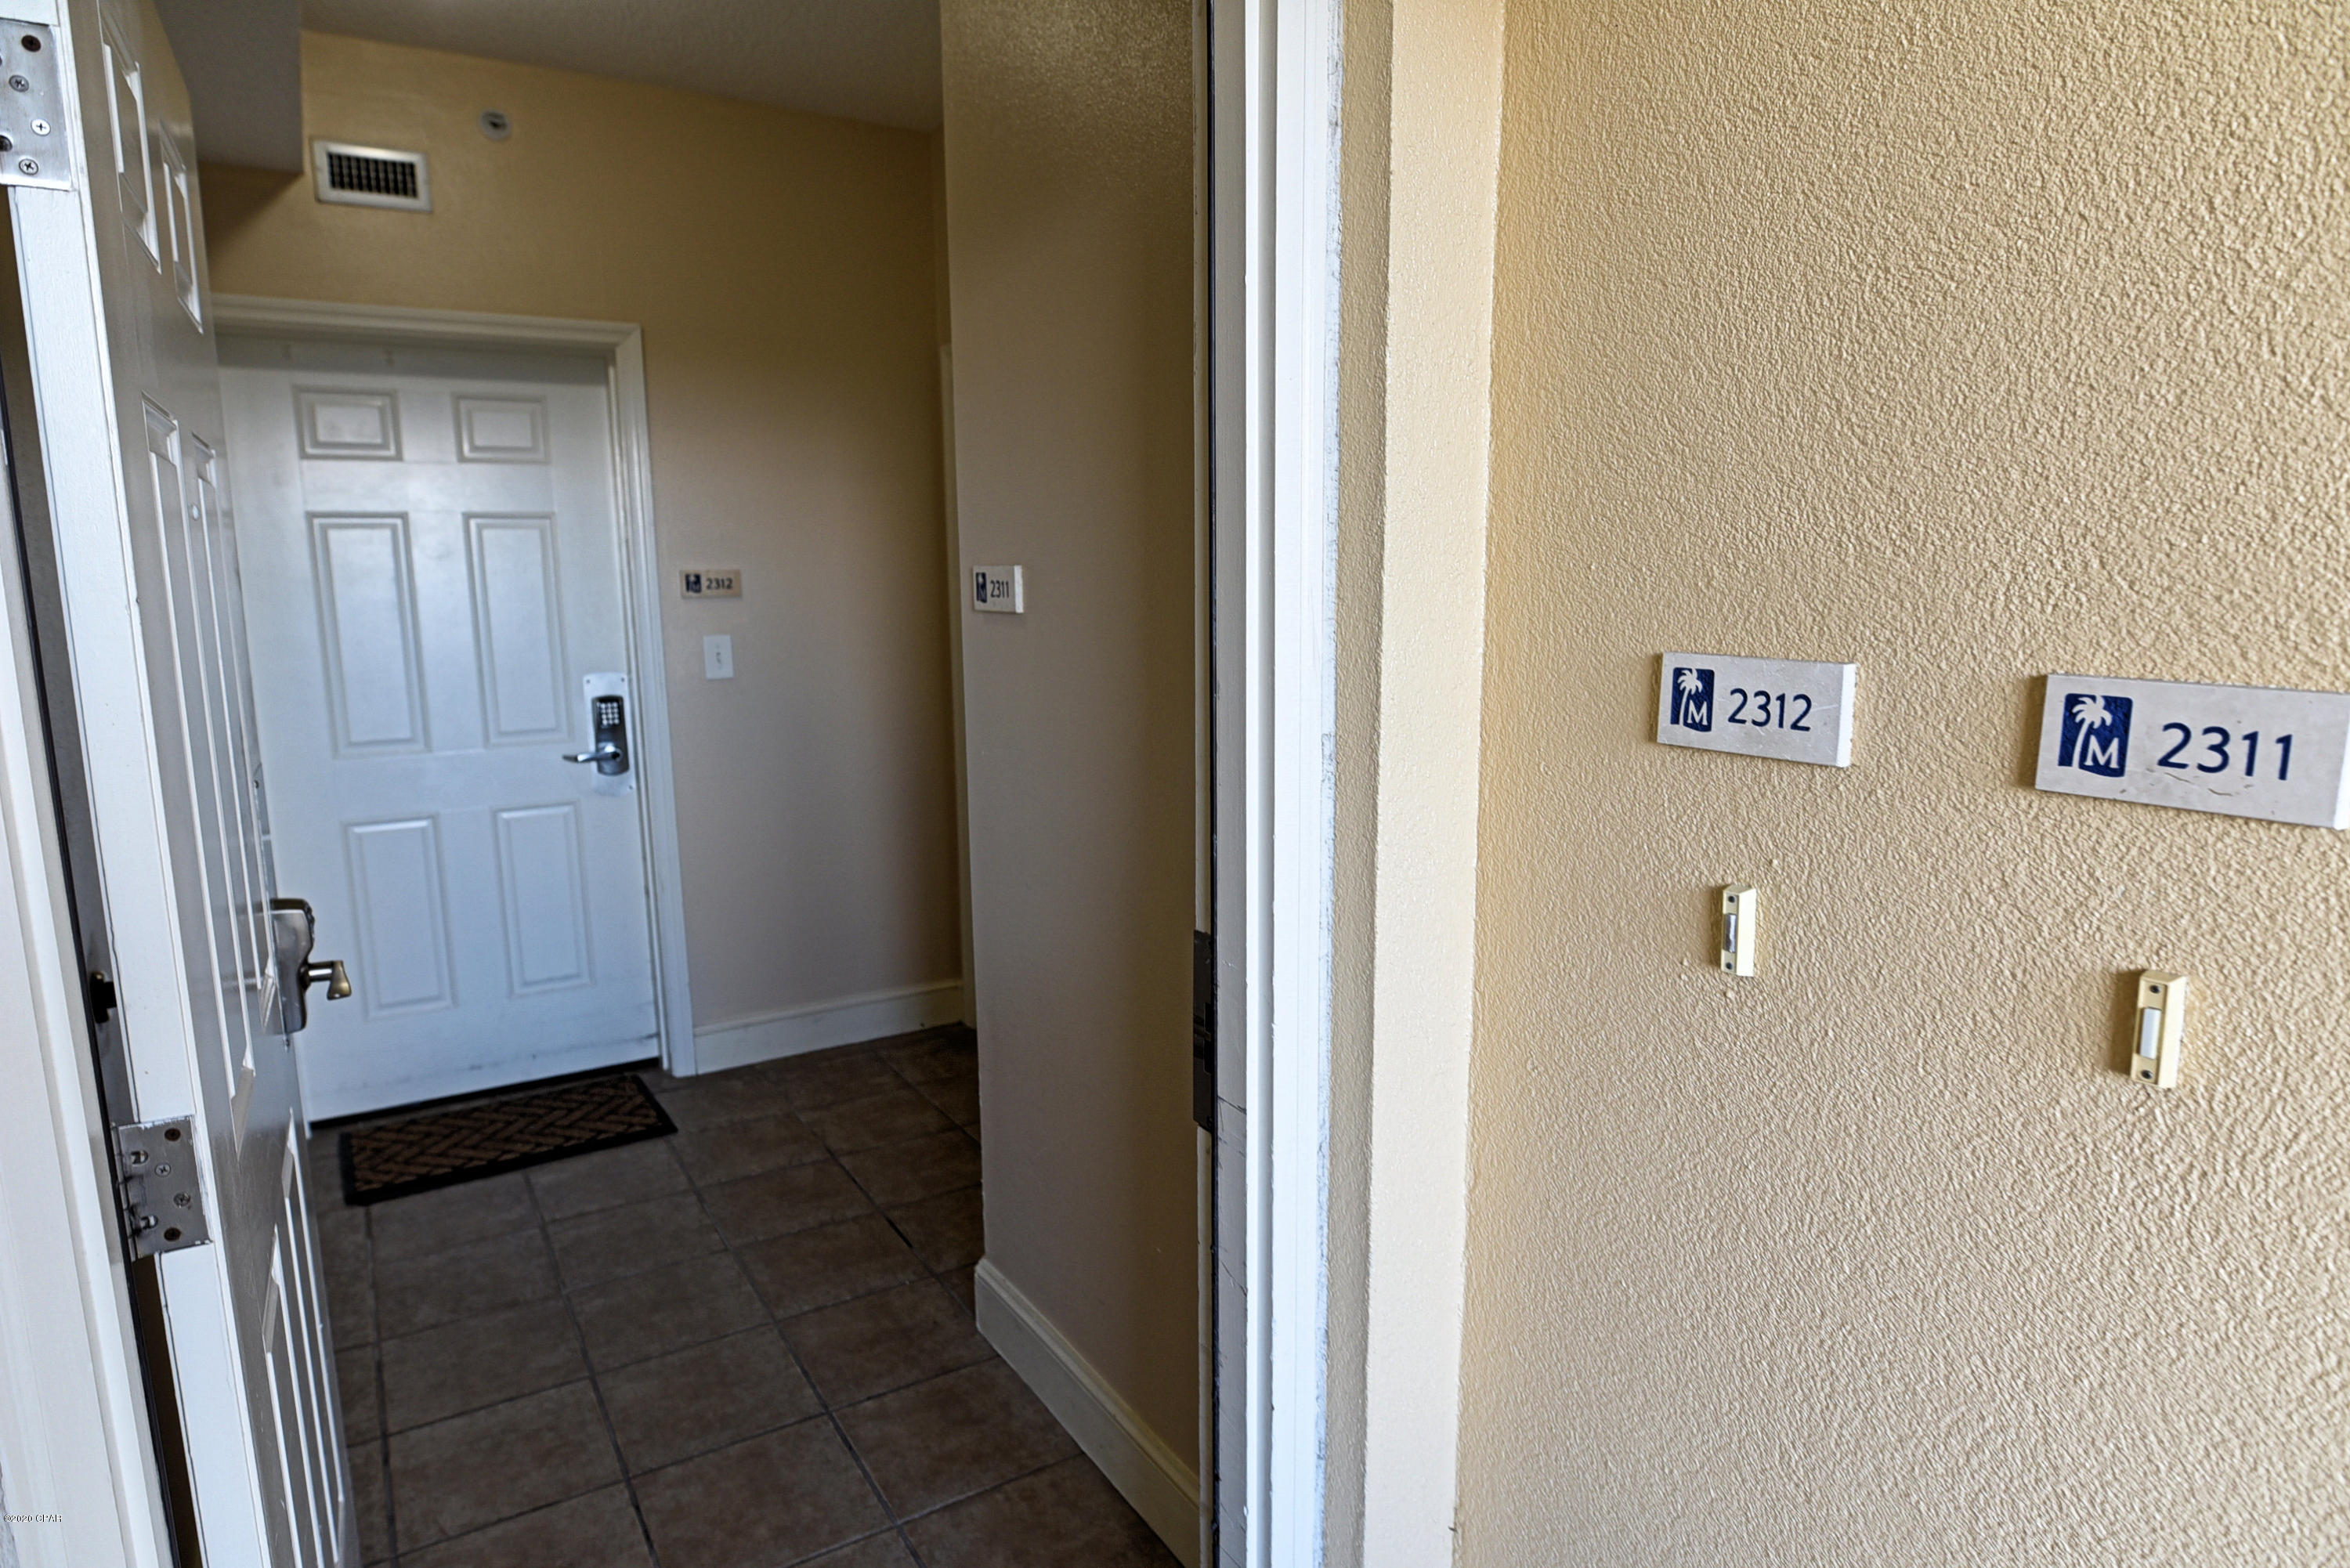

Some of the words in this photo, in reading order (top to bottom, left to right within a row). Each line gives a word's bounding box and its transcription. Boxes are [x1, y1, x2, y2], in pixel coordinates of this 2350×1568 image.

[706, 577, 733, 591] 2312
[990, 580, 1010, 598] 2311
[1687, 699, 1708, 726] M
[1727, 688, 1813, 732] 2312
[2083, 735, 2120, 769] M
[2157, 722, 2293, 781] 2311
